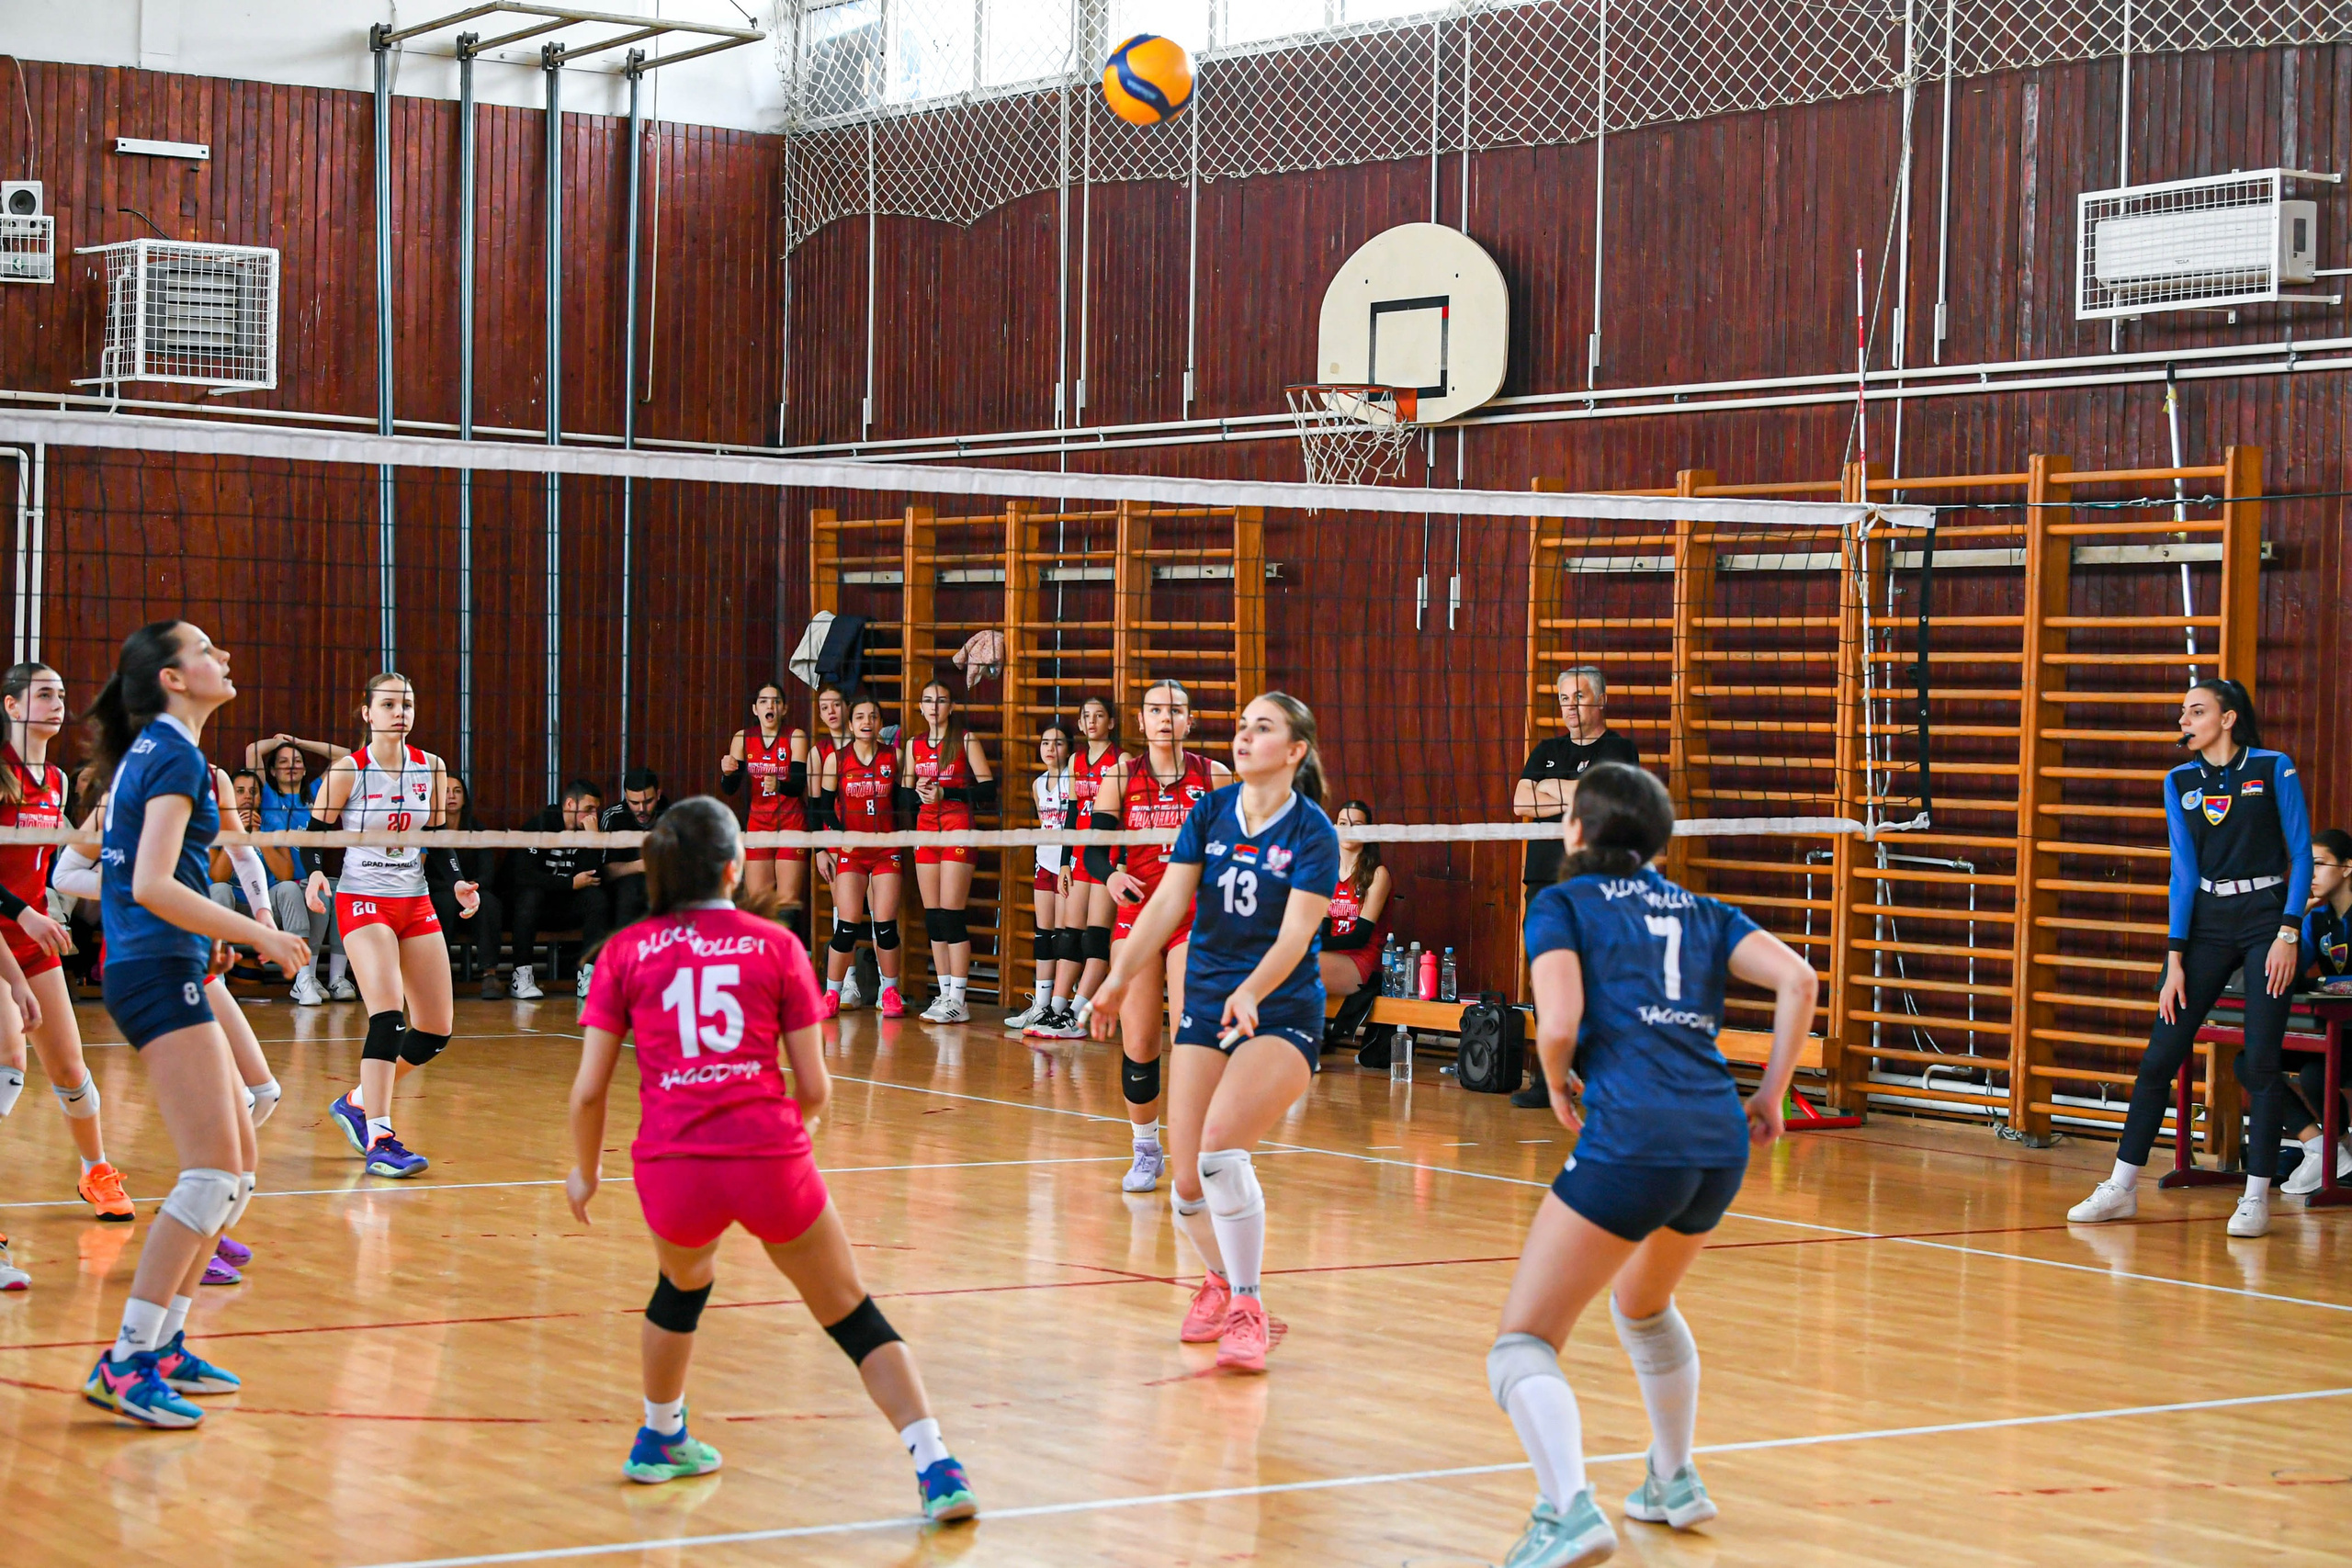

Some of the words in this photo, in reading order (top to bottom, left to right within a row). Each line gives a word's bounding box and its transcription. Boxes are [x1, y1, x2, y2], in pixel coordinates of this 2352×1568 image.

[866, 799, 875, 816] 8
[387, 813, 412, 832] 20
[1216, 866, 1258, 917] 13
[352, 901, 377, 917] 20
[1644, 915, 1682, 1001] 7
[183, 981, 200, 1006] 8
[662, 964, 745, 1059] 15
